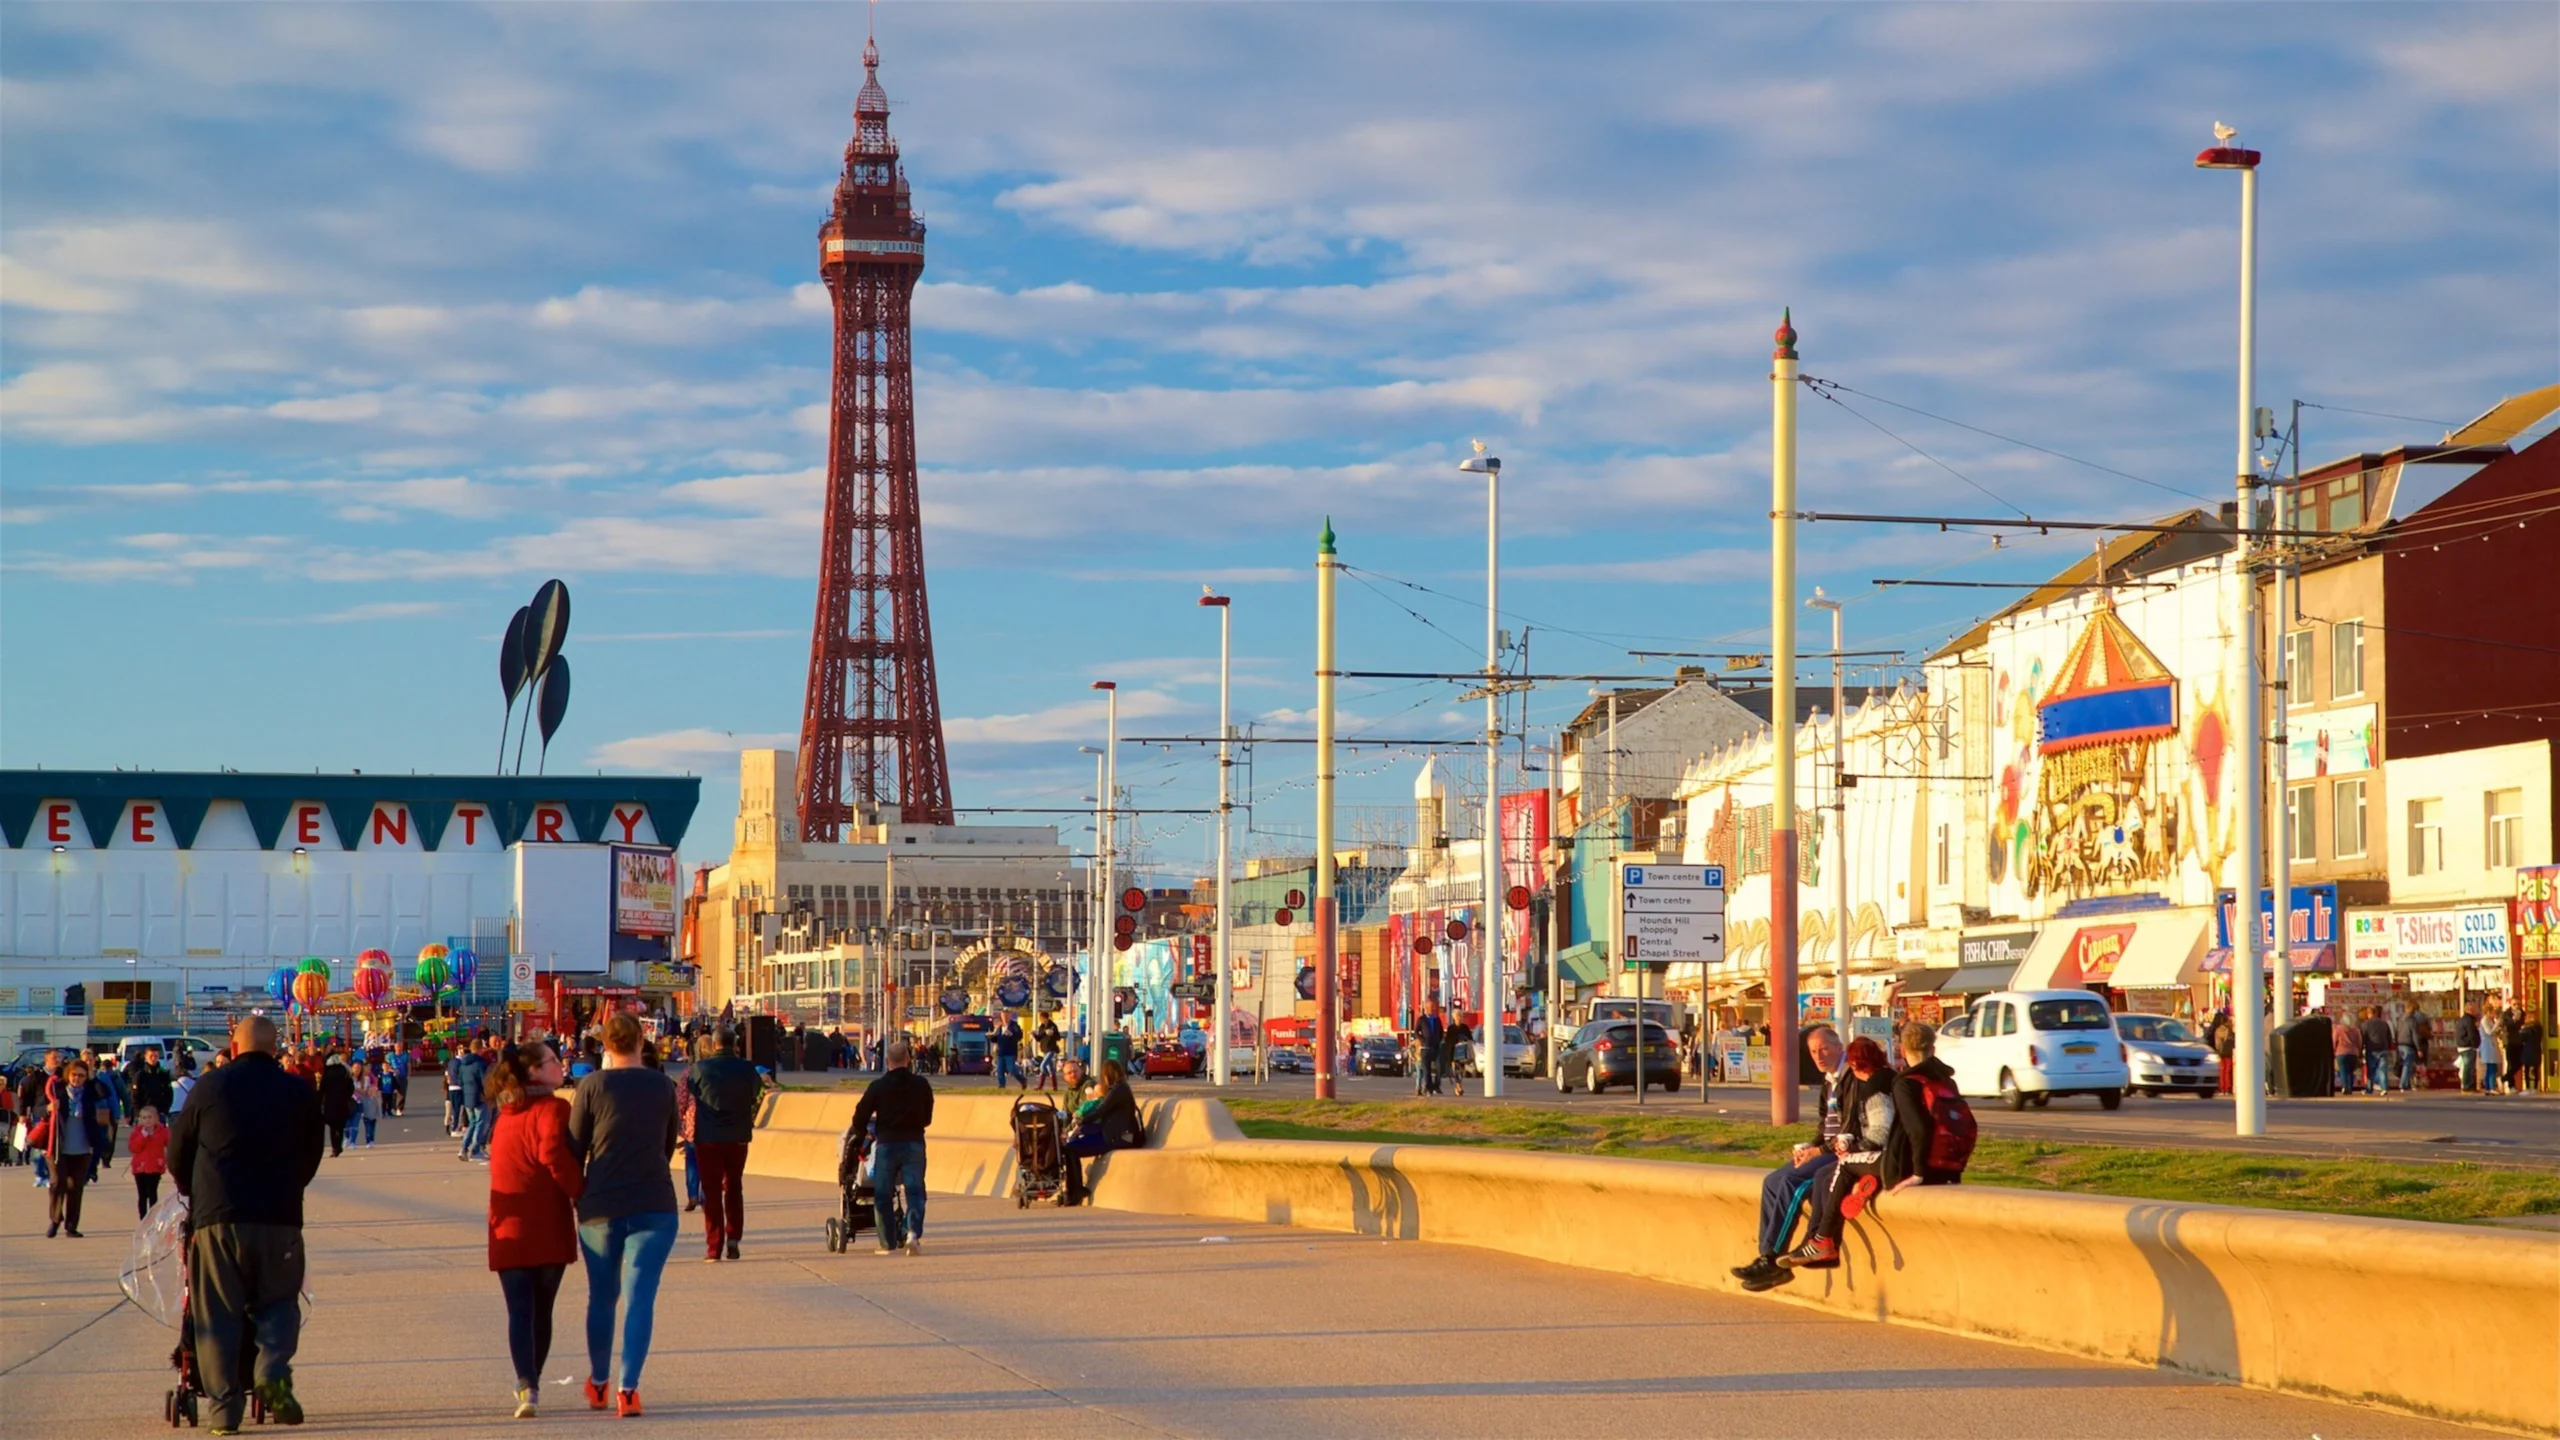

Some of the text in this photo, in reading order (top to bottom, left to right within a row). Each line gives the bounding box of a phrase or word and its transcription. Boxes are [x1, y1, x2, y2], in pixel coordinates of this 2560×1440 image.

[298, 806, 644, 846] ENTRY
[1630, 869, 1719, 885] P Town centre P
[1638, 896, 1692, 904] Town centre
[1639, 916, 1690, 925] Hounds Hill
[2356, 917, 2385, 933] ROCK
[2464, 913, 2496, 932] COLD
[1639, 926, 1678, 935] shopping
[2395, 916, 2453, 945] T-Shirts
[1639, 938, 1672, 946] Central
[2459, 935, 2506, 955] DRINKS
[1014, 937, 1054, 973] ISLND
[1639, 949, 1700, 957] Chapel Street
[1964, 942, 1980, 963] FISH
[1980, 941, 1987, 962] &
[1987, 939, 2010, 961] CHIPS
[1811, 996, 1835, 1007] FRE
[1271, 1029, 1296, 1038] Funla
